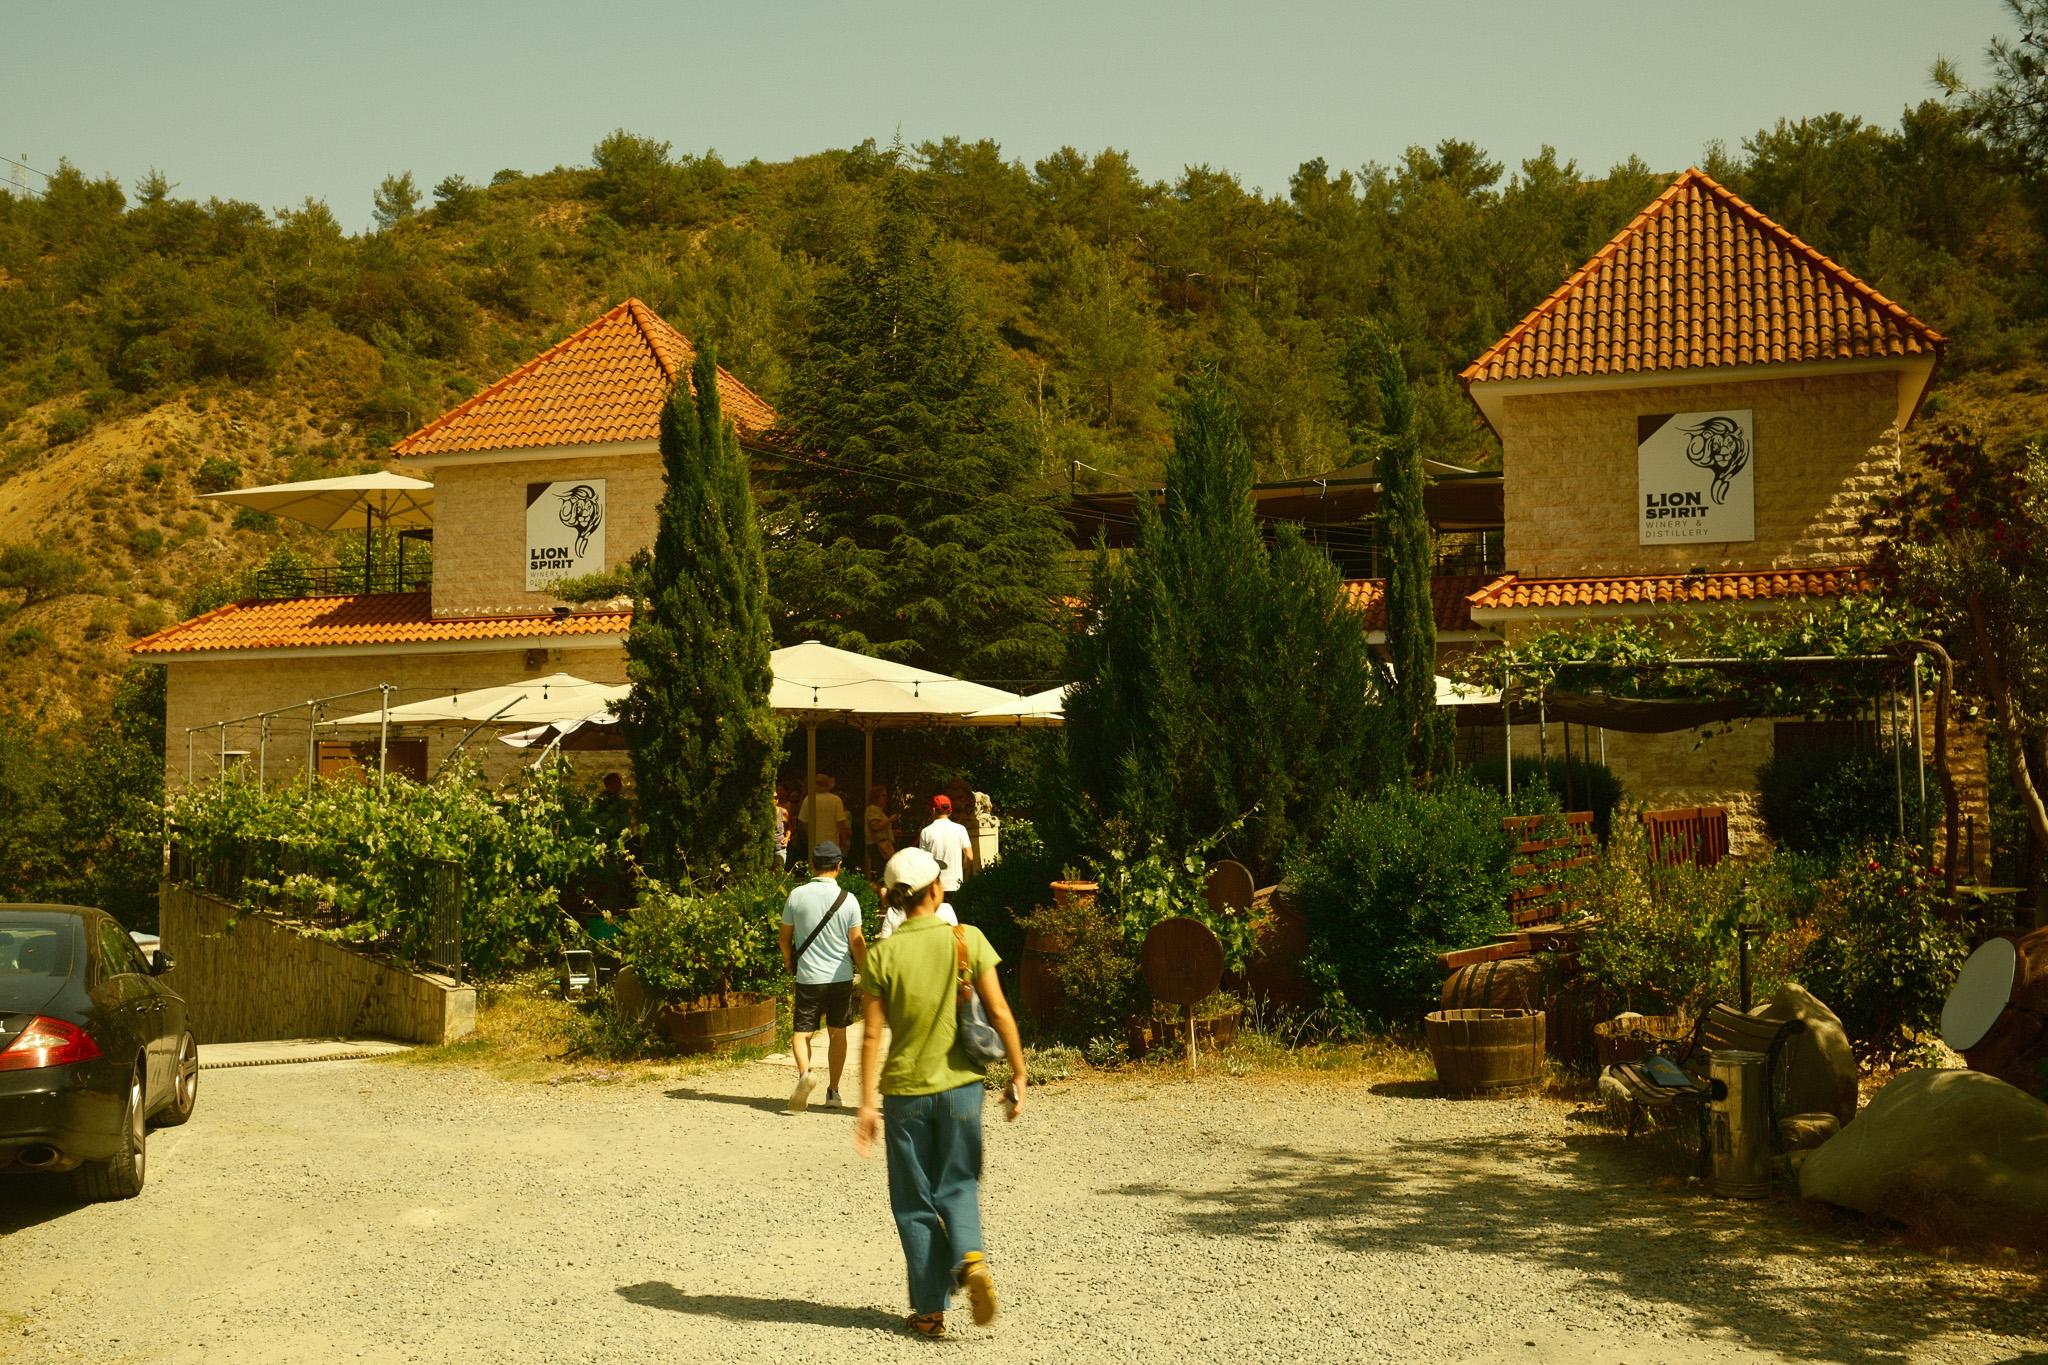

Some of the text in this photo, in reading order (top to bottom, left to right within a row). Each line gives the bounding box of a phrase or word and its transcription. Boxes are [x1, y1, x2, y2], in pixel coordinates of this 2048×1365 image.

[1646, 491, 1701, 507] LION
[1646, 506, 1709, 519] SPIRIT
[1646, 520, 1687, 528] WINERY
[1646, 529, 1709, 538] DISTILLERY
[531, 547, 568, 560] LION
[530, 559, 574, 570] SPIRIT
[530, 570, 559, 578] WINERY
